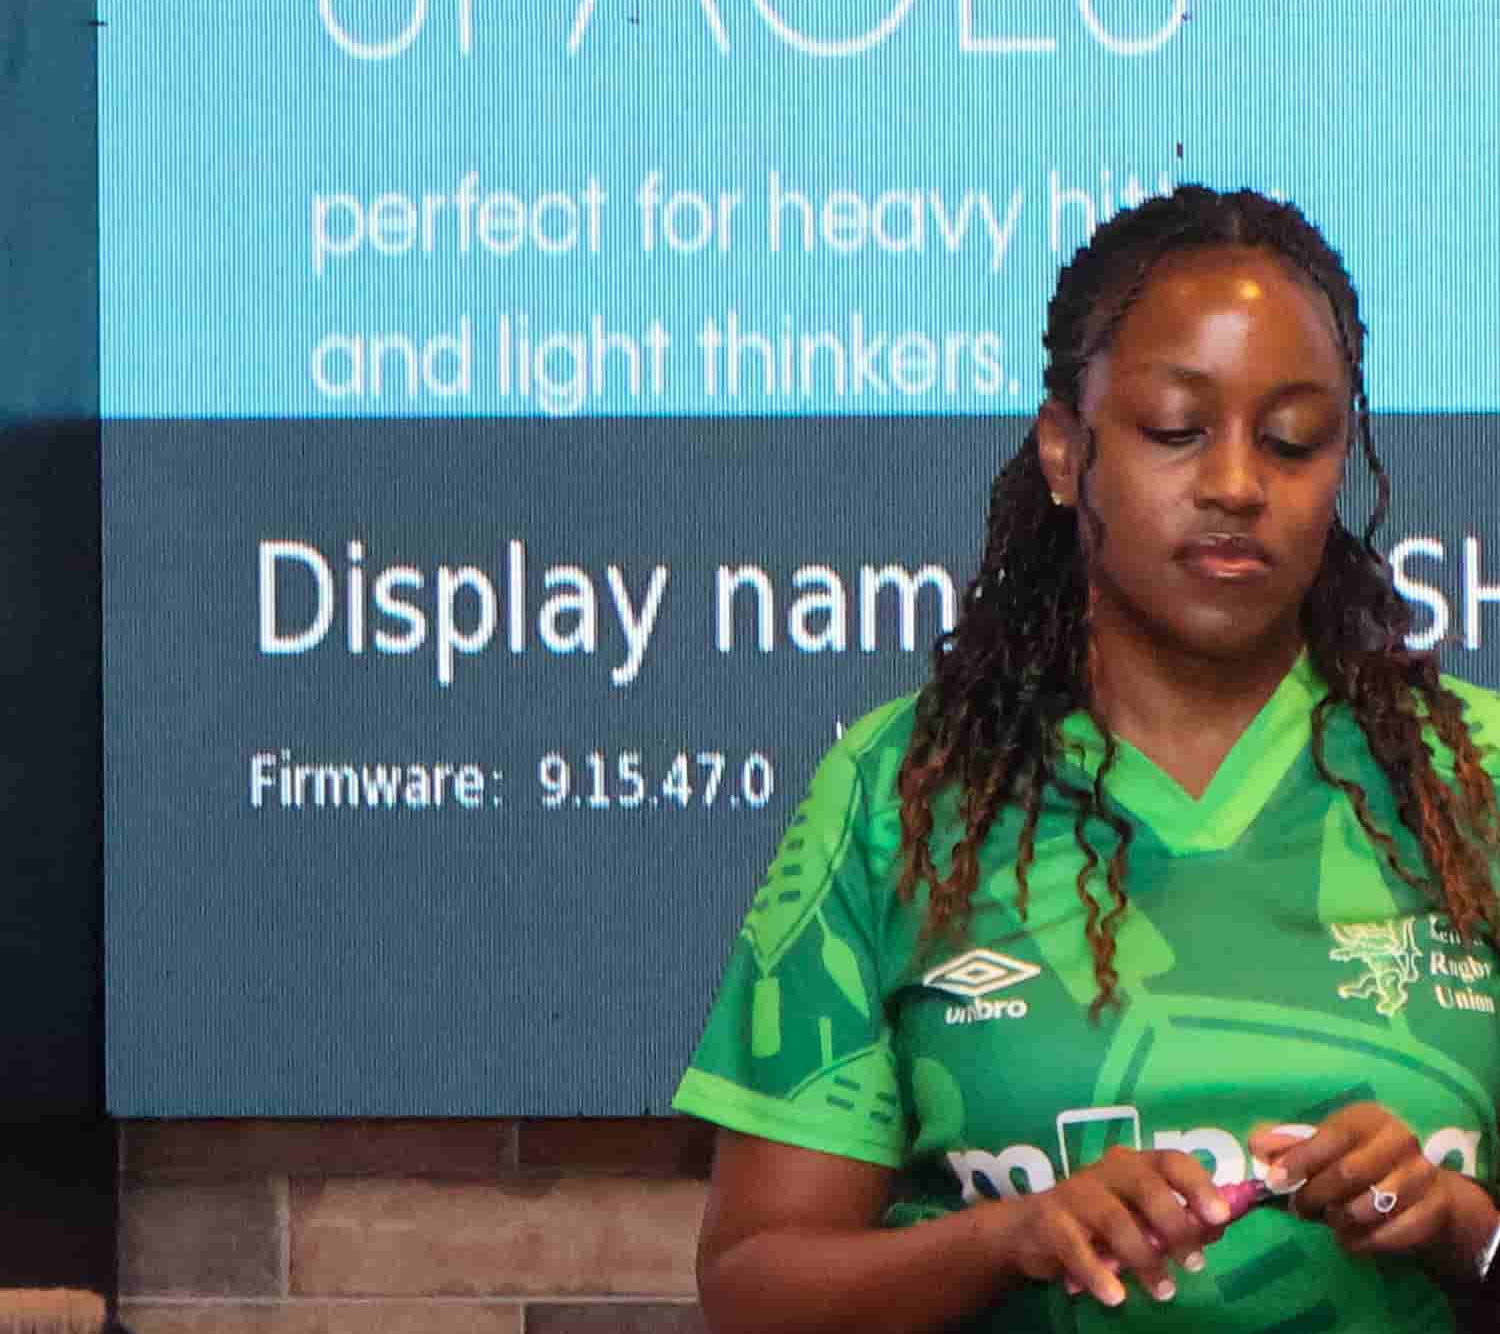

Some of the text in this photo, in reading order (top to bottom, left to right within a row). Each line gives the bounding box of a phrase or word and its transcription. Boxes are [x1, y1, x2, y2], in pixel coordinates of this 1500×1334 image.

[311, 170, 607, 275] perfect
[637, 170, 743, 253] for
[767, 169, 1026, 273] heavy
[311, 312, 1022, 415] and light thinkers.
[257, 539, 670, 685] Display
[715, 564, 957, 653] nam
[250, 751, 775, 808] Firmware: 9.15.47.0
[945, 997, 1028, 1024] umbro
[1434, 983, 1495, 1013] Union
